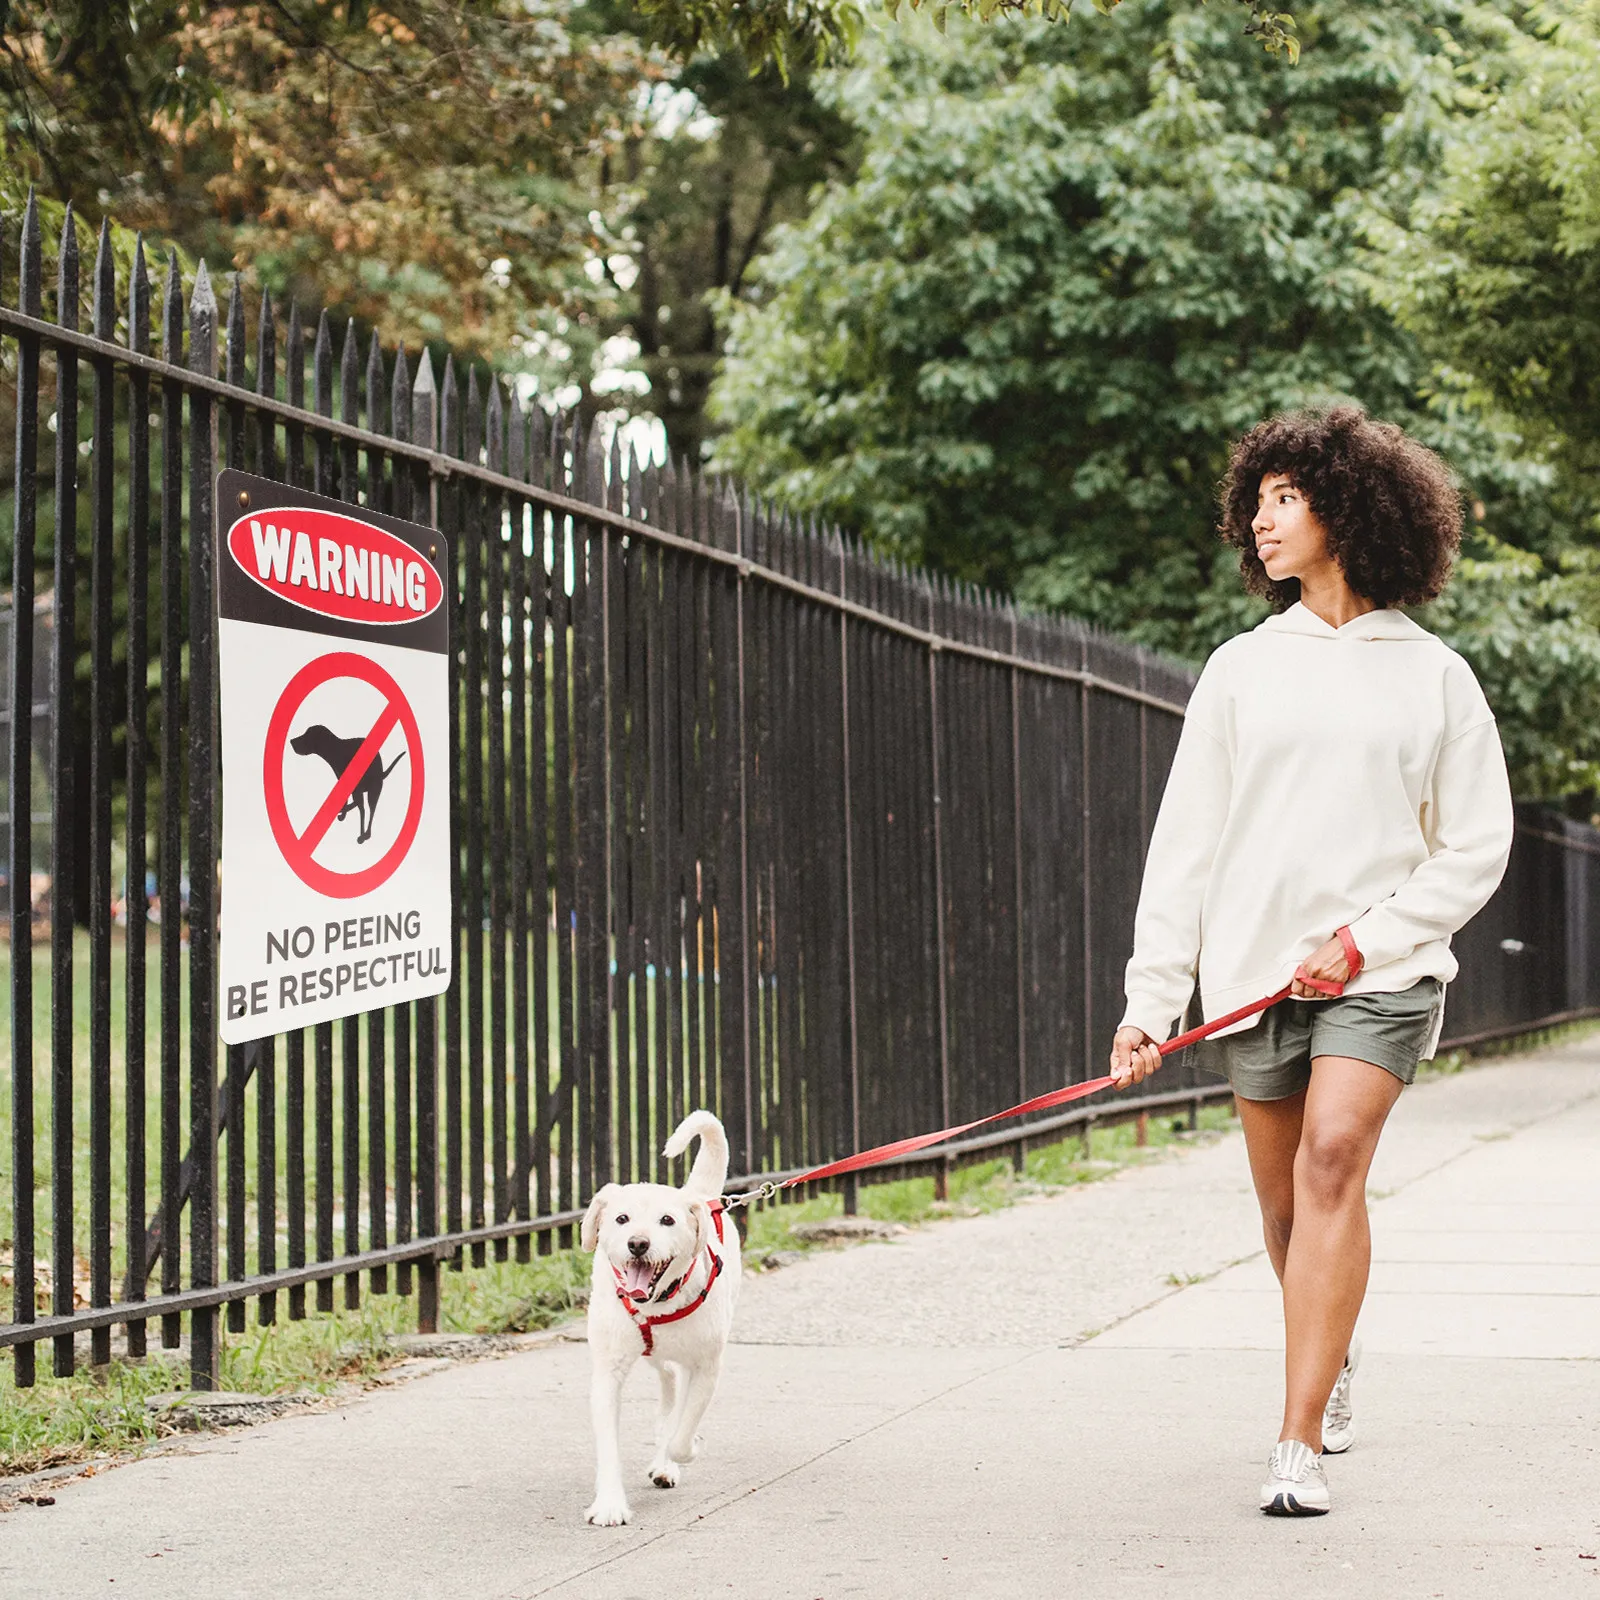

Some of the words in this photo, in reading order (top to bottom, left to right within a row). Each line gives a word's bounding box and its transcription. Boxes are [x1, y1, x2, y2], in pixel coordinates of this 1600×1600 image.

[250, 520, 426, 612] WARNING
[266, 925, 315, 964] NO
[325, 910, 421, 954] PEEING
[228, 980, 268, 1020] BE
[279, 947, 447, 1009] RESPECTFUL
